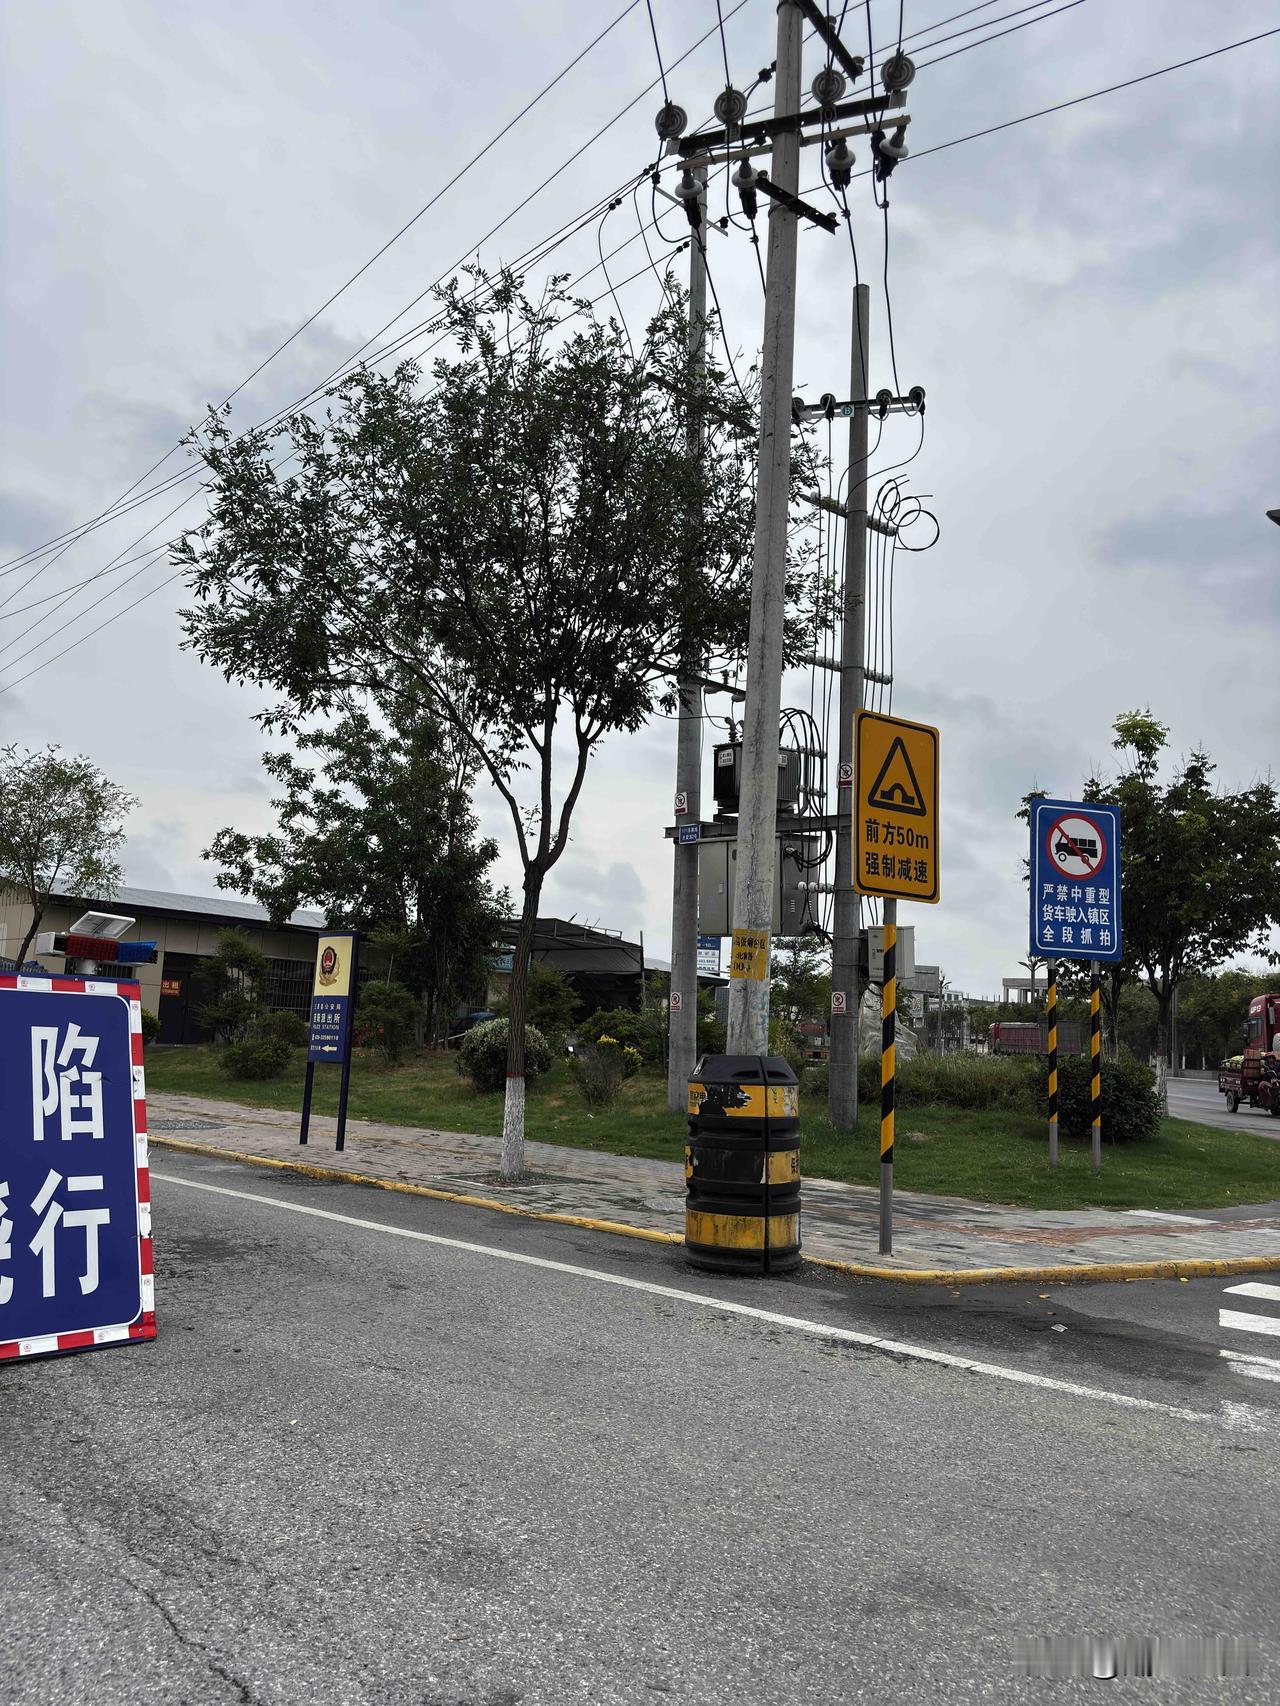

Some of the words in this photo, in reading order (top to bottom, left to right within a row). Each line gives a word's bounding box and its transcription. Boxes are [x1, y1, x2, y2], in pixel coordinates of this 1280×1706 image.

[865, 818, 929, 849] 前方50m
[865, 851, 928, 883] 强制减速
[1042, 883, 1110, 905] 严禁中重型
[1042, 904, 1110, 925] 货车驶入镇区
[1042, 924, 1111, 946] 全段抓拍
[31, 1022, 104, 1141] 陷
[0, 1168, 110, 1305] 行
